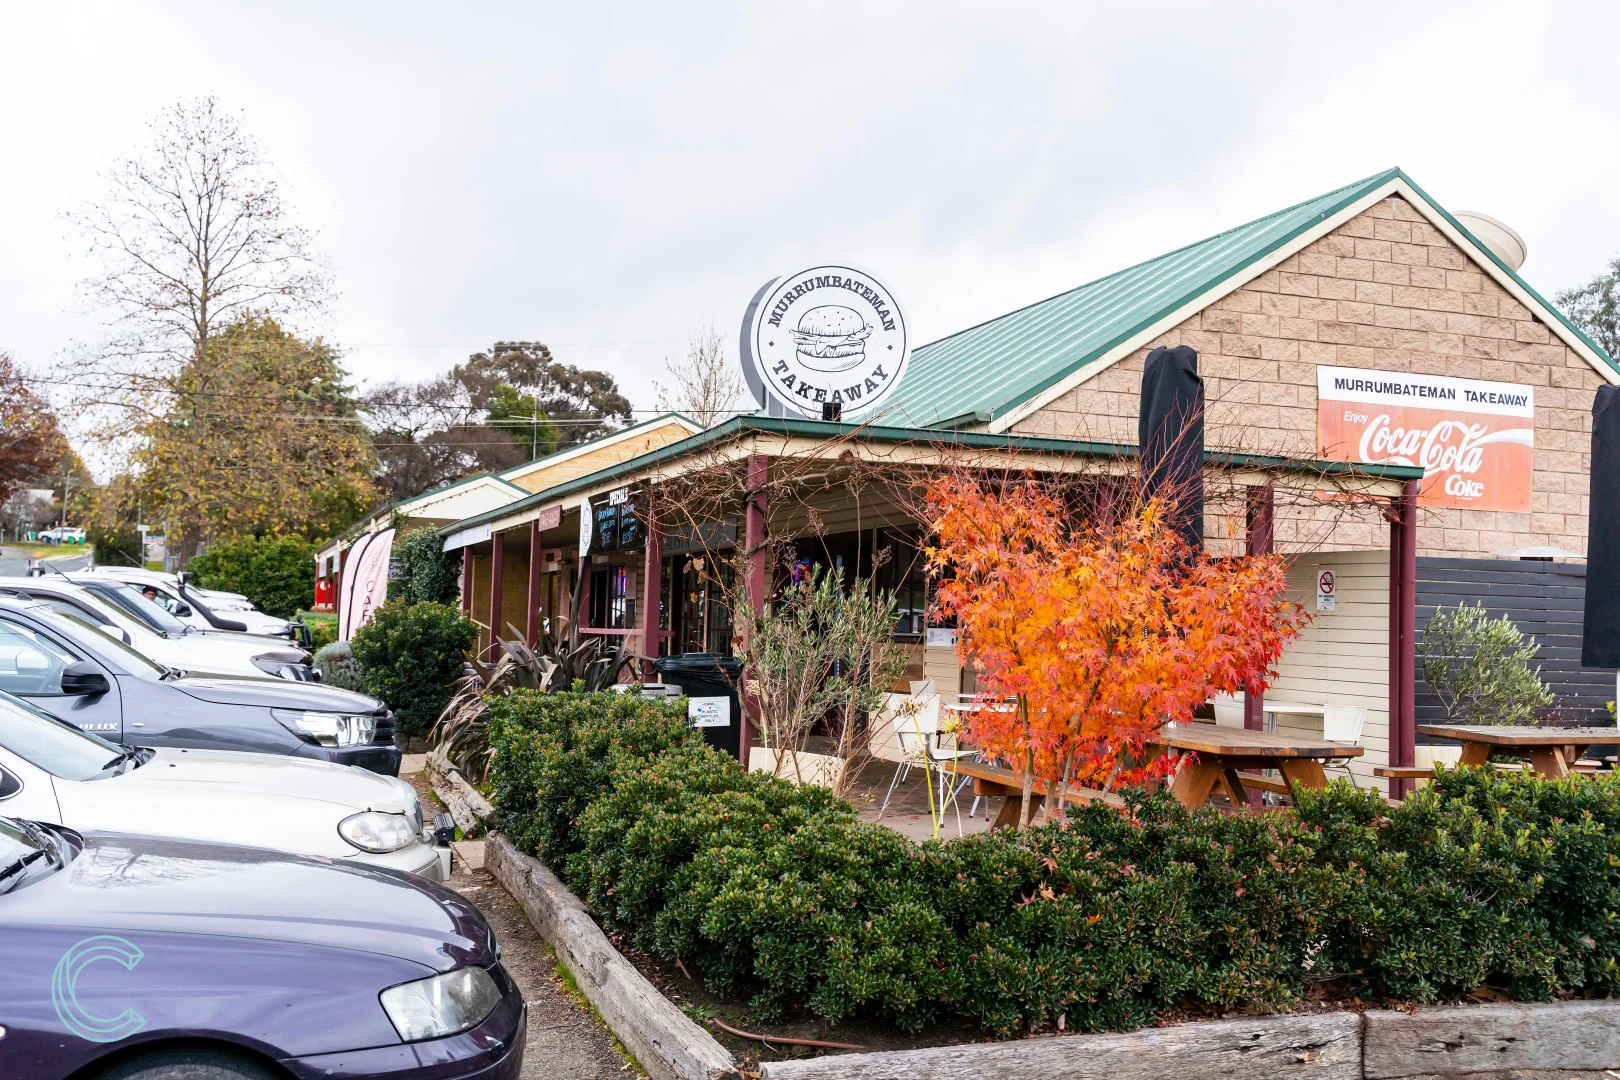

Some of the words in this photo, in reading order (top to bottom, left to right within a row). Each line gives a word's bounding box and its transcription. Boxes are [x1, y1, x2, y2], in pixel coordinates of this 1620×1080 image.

[768, 275, 897, 332] MURRUMBATEMAN
[772, 359, 888, 403] TAKEAWAY
[1334, 378, 1456, 400] MURRUMBATEMAN
[1464, 390, 1528, 407] TAKEAWAY
[1344, 411, 1368, 424] Enjoy
[1358, 414, 1488, 475] Coca-Cola
[1444, 474, 1485, 497] Coke
